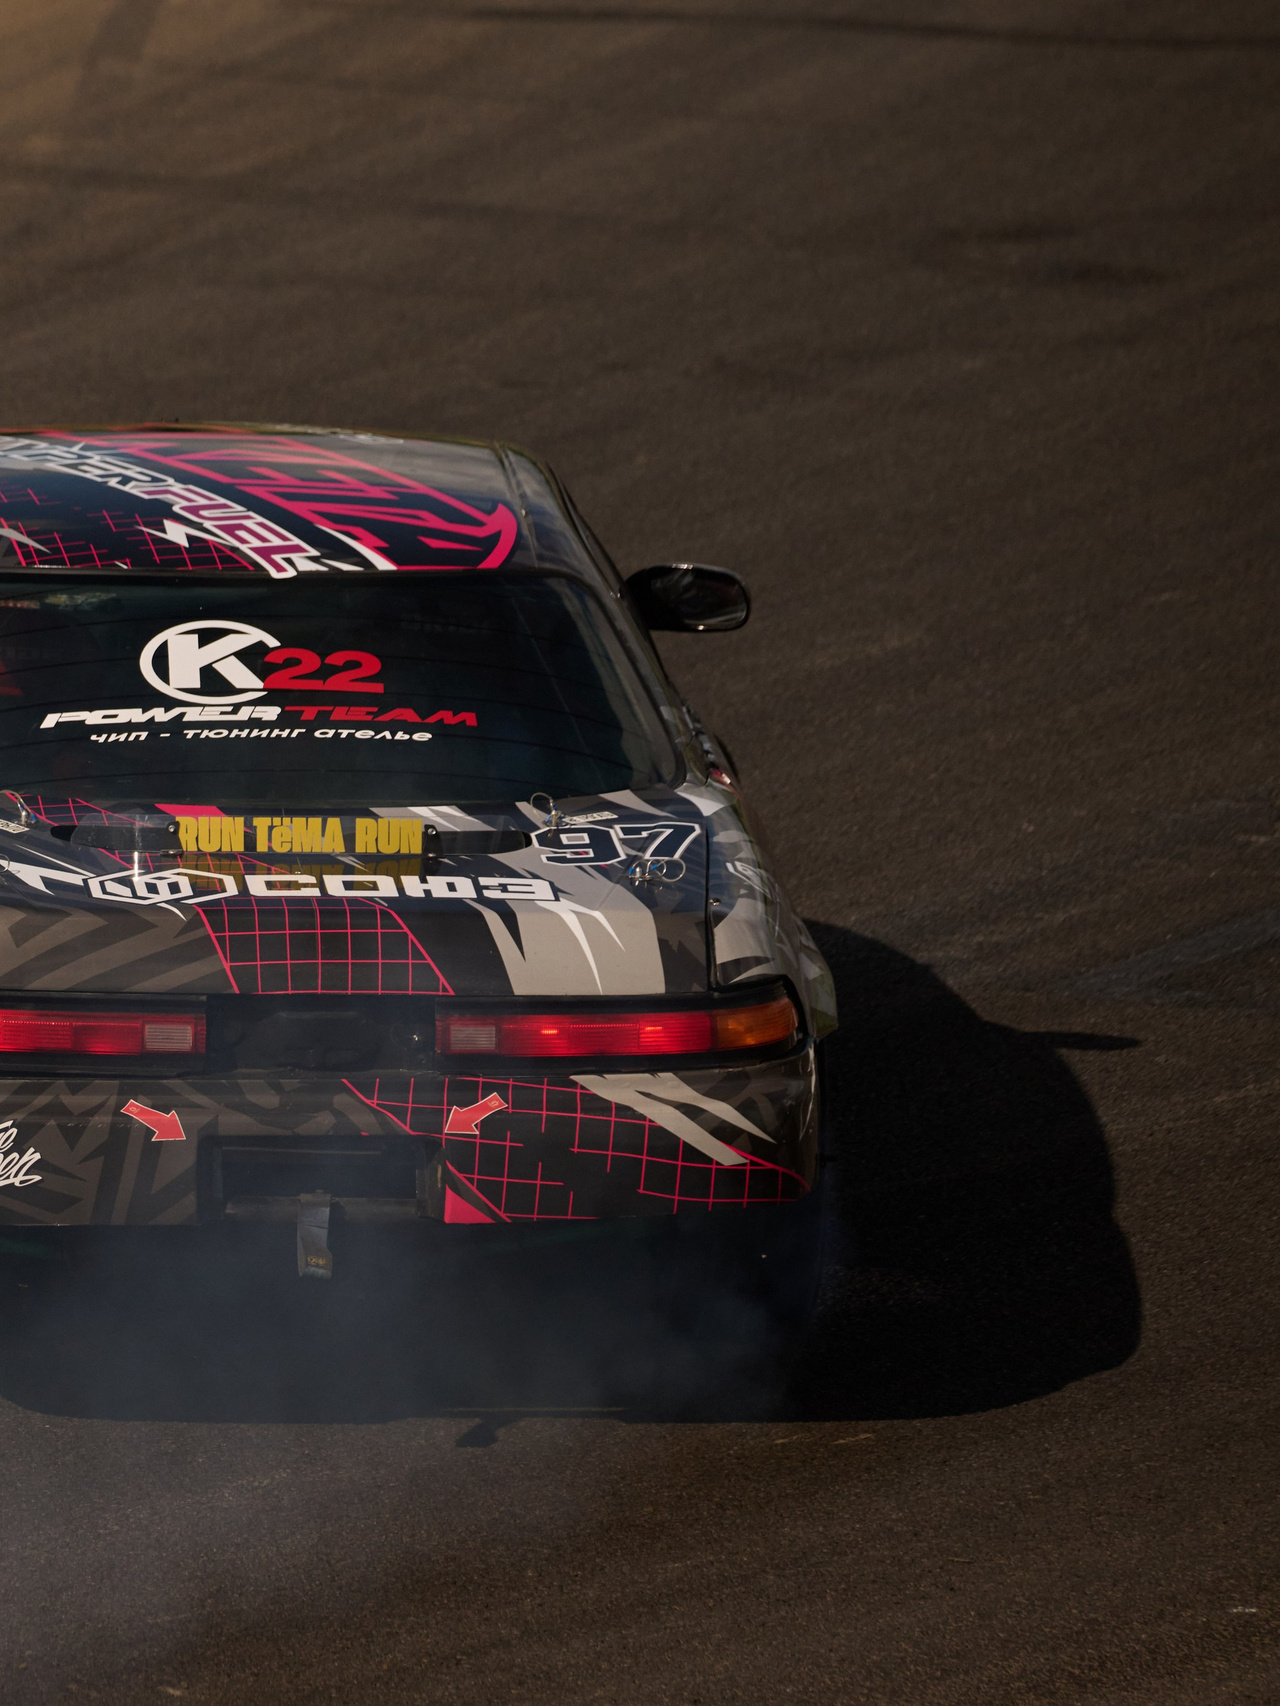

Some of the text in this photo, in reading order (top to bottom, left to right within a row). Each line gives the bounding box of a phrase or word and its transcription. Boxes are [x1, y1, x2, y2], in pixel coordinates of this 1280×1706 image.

[175, 816, 245, 852] RUN
[355, 818, 423, 854] RUN
[530, 821, 702, 866] 97
